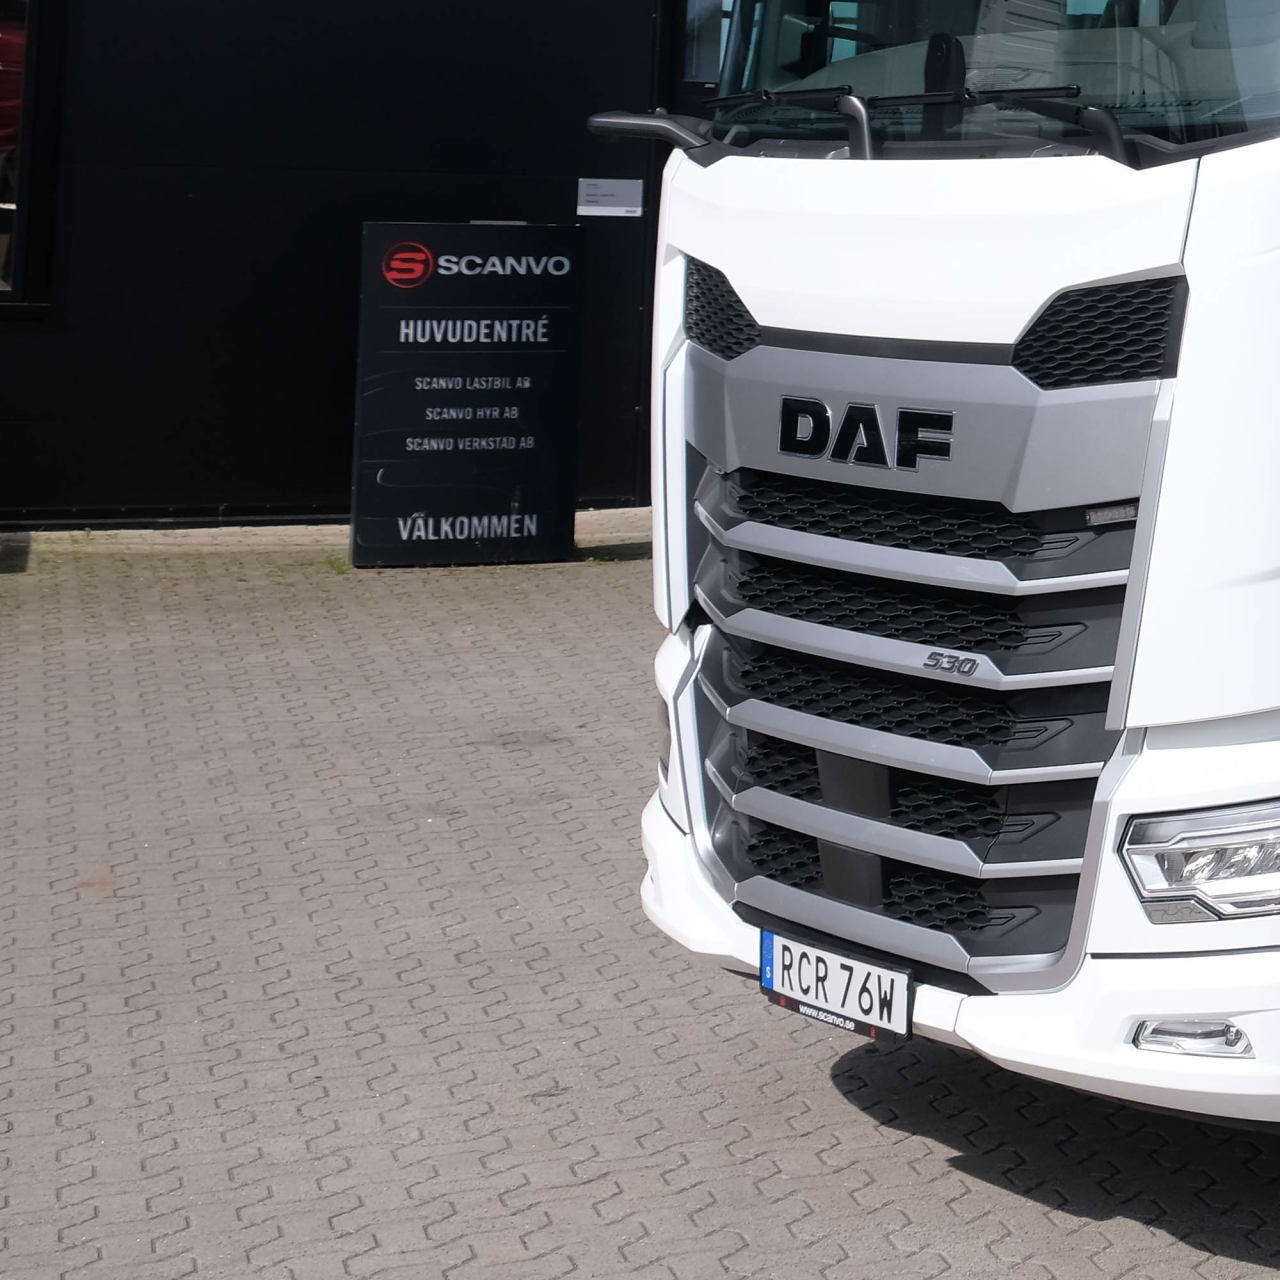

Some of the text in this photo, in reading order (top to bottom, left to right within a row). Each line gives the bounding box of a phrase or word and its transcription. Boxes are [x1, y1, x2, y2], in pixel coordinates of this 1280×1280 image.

[437, 255, 571, 277] SCANVO
[399, 315, 549, 343] HUVUDENTRÉ
[415, 376, 531, 390] SCANVO LASTBIL AB
[425, 406, 519, 420] SCANVO HYR AB
[405, 436, 535, 451] SCANVO VERKSTAD AB
[777, 394, 957, 473] DAF
[397, 513, 538, 541] VÄLKOMMEN
[923, 651, 980, 677] 530
[765, 966, 771, 979] S
[781, 943, 895, 1024] RCR 76W
[799, 1003, 856, 1032] www.scanvo.se
